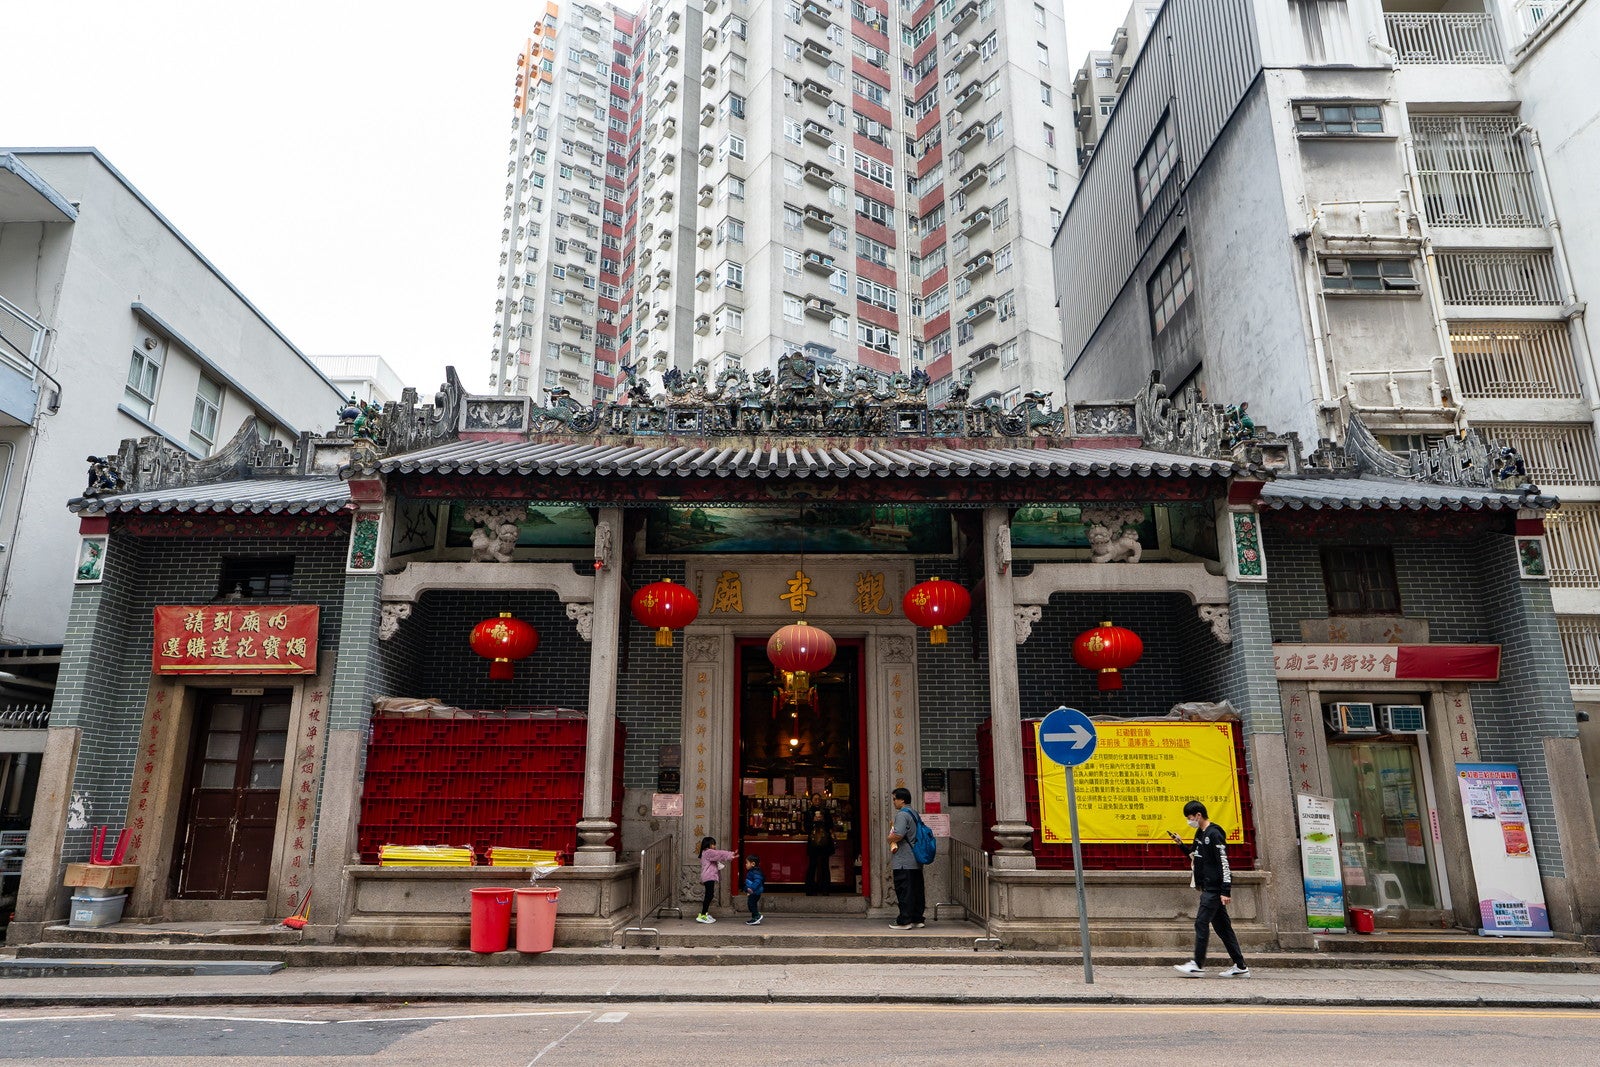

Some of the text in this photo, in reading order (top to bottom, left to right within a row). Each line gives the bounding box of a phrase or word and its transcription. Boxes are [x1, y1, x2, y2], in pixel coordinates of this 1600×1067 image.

[709, 569, 894, 615] 觀音廟
[183, 610, 288, 634] 請到廟內
[161, 635, 307, 659] 選購蓮花寶燭
